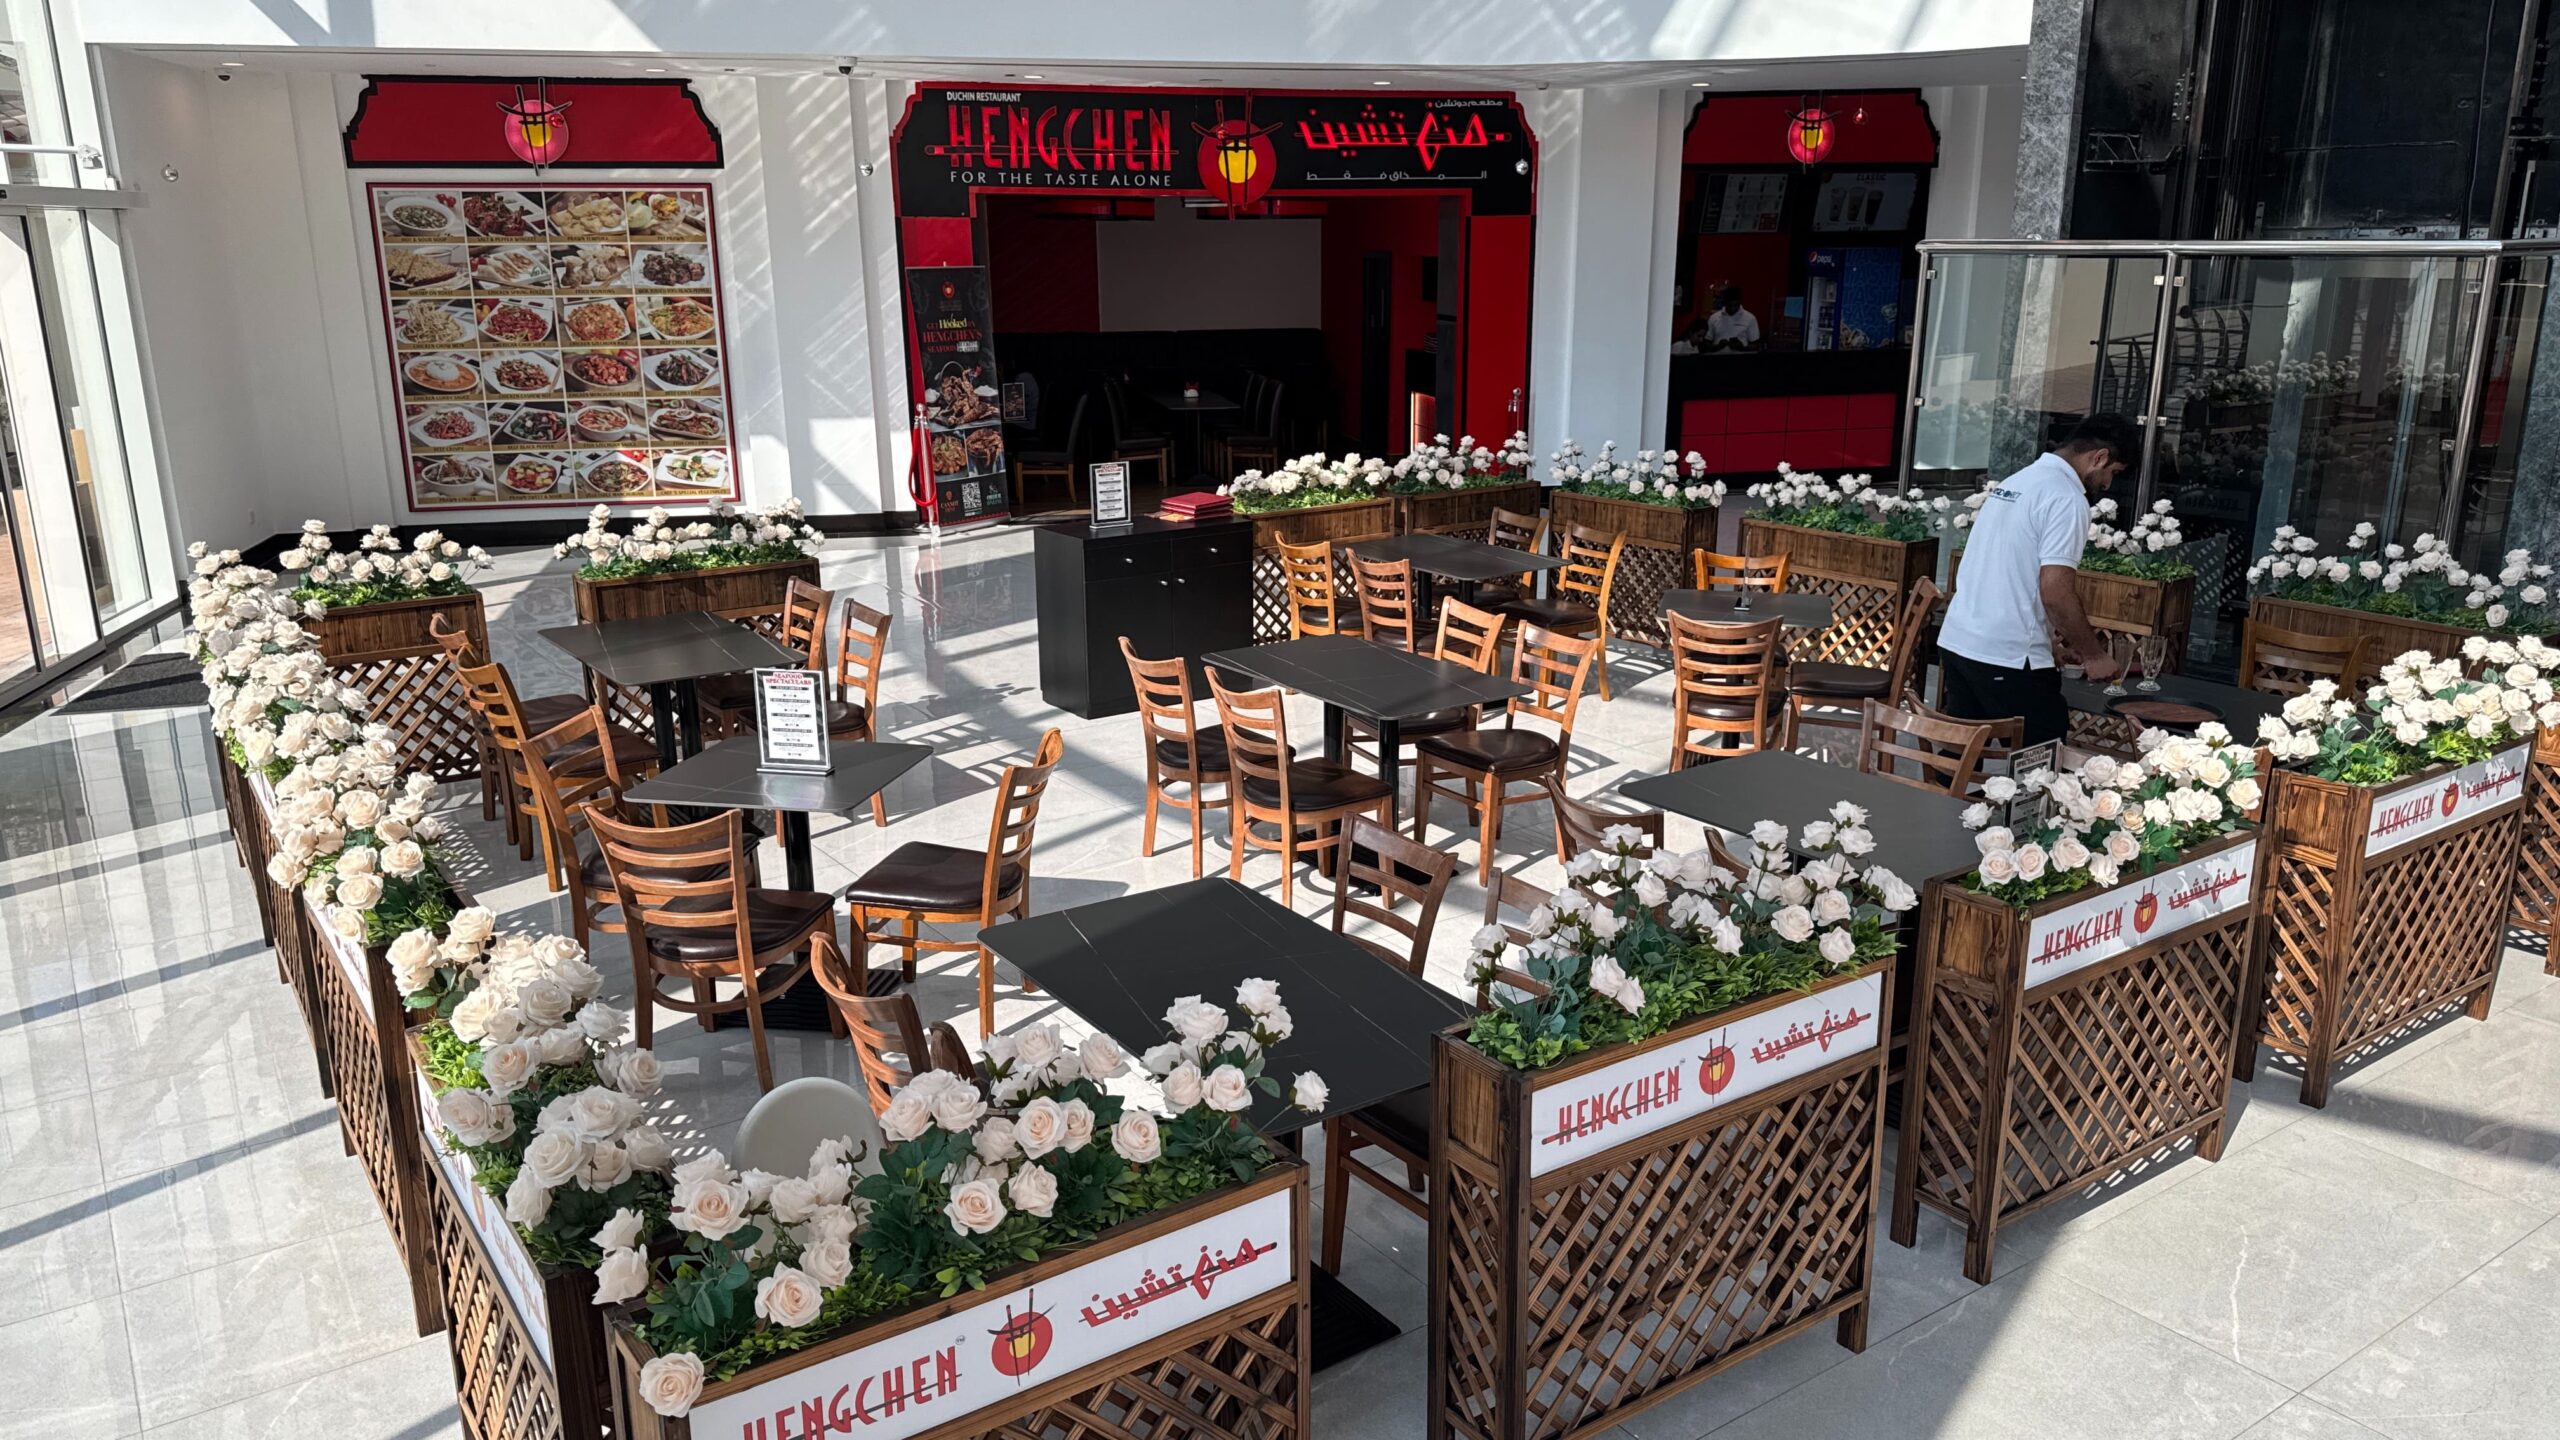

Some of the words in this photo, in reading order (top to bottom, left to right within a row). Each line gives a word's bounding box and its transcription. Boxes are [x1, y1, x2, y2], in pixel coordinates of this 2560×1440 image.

[946, 91, 975, 101] DUCHIN
[976, 92, 1021, 103] RESTAURANT
[947, 104, 1172, 172] HENGCHEN
[949, 171, 987, 184] FOR
[998, 172, 1033, 185] THE
[1045, 173, 1099, 186] TASTE
[1110, 174, 1171, 187] ALONE
[2377, 793, 2436, 838] HENGCHEN
[2041, 906, 2124, 966] HENGCHEN
[1558, 1065, 1680, 1146] HENGCHEN
